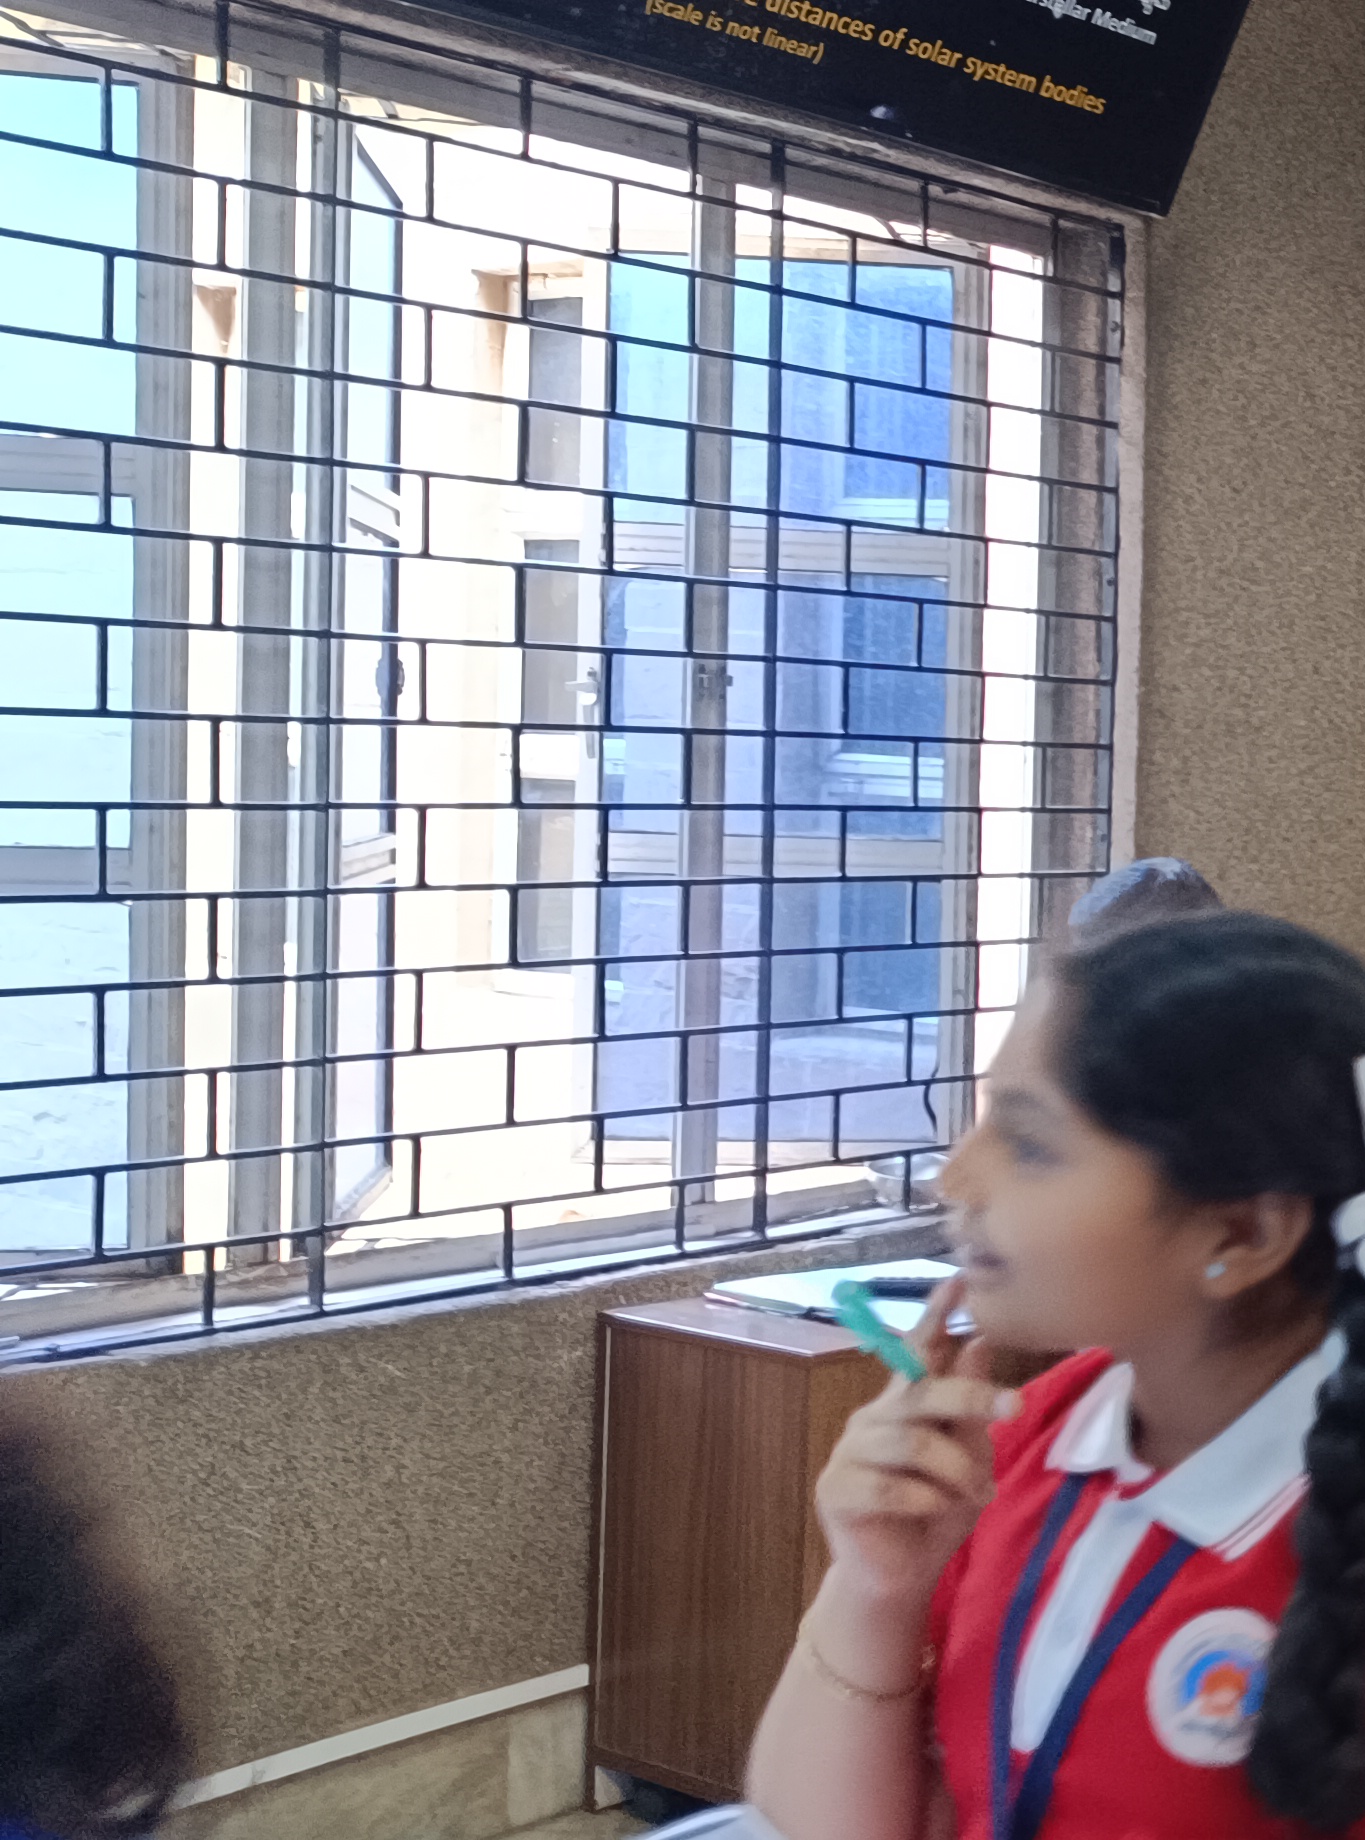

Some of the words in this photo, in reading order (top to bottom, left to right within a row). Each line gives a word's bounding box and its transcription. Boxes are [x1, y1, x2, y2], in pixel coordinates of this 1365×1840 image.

[705, 10, 724, 32] is
[725, 21, 761, 43] not
[762, 27, 825, 64] linear)
[765, 0, 876, 41] distances
[878, 28, 909, 50] of
[905, 39, 963, 68] solar
[963, 56, 1037, 93] system
[1039, 75, 1107, 114] bodies
